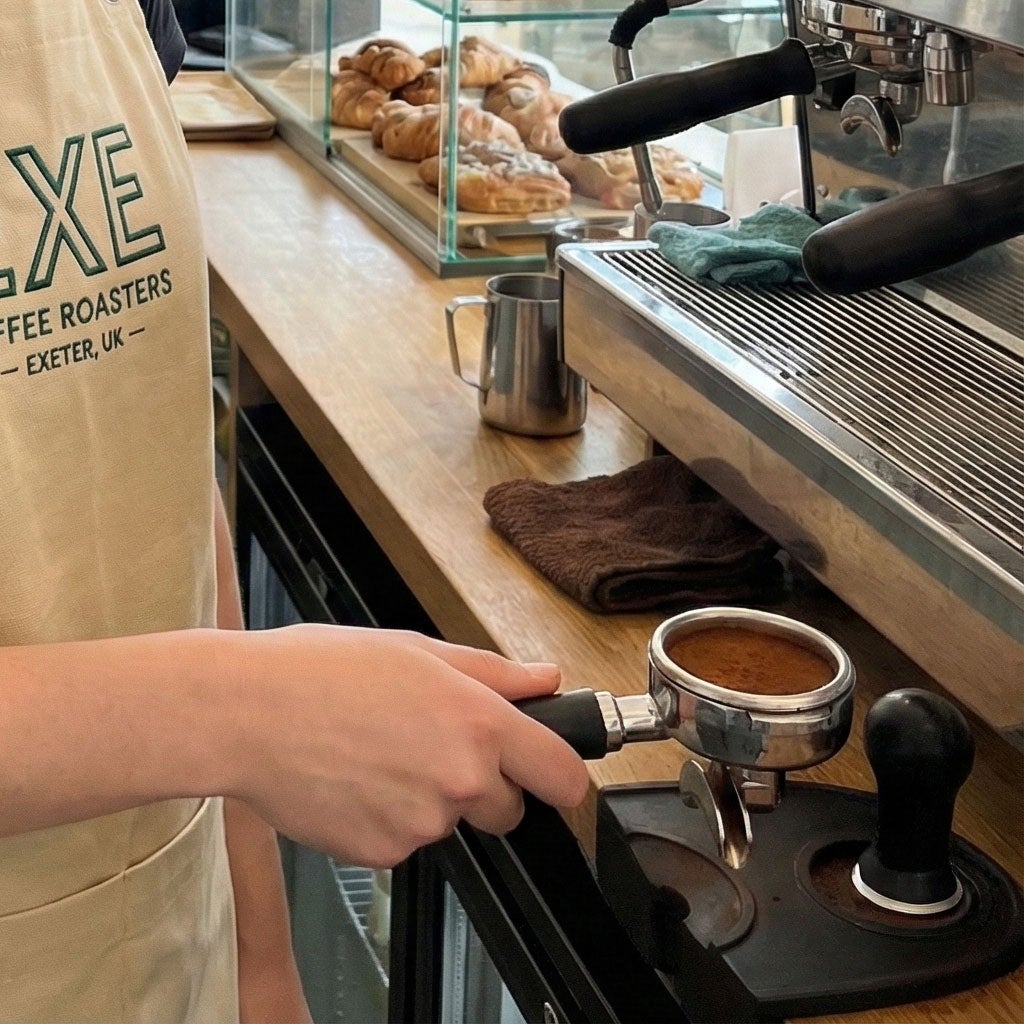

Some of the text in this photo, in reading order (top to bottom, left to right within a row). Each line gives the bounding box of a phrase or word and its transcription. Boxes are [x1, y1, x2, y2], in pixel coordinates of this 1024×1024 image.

[60, 268, 172, 329] ROASTERS
[26, 326, 124, 376] EXETER, UK
